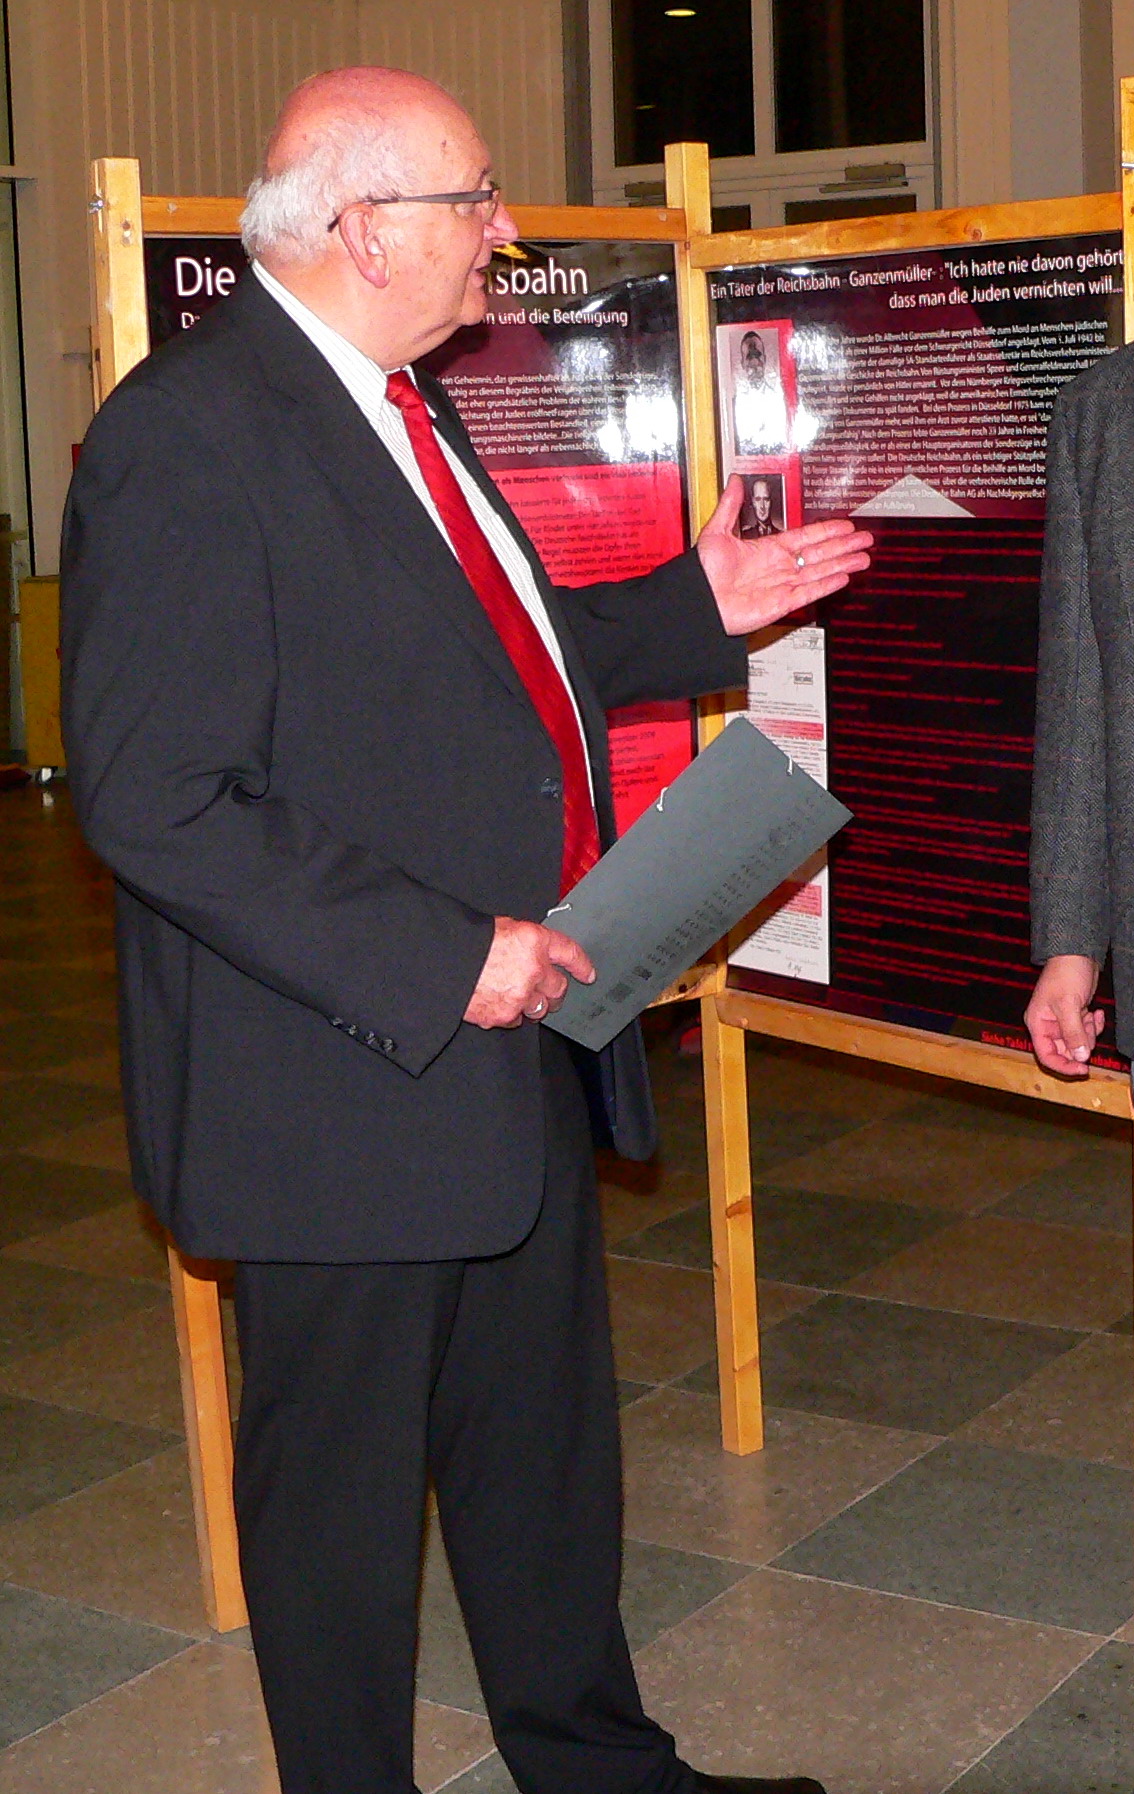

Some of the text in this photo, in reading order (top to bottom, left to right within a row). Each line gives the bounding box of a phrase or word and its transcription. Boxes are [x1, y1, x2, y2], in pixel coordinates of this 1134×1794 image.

[175, 257, 235, 296] Die
[710, 283, 727, 299] Ein
[728, 282, 755, 297] Täter
[757, 277, 775, 296] der
[777, 273, 840, 293] Reichsbahn
[972, 258, 1005, 277] hatte
[1008, 255, 1029, 273] nie
[1032, 253, 1073, 273] davon
[889, 291, 916, 309] dass
[919, 291, 946, 307] man
[949, 286, 968, 305] die
[971, 283, 1010, 303] Juden
[1013, 278, 1085, 300] vernichten
[499, 308, 628, 327] und die Beteiligung
